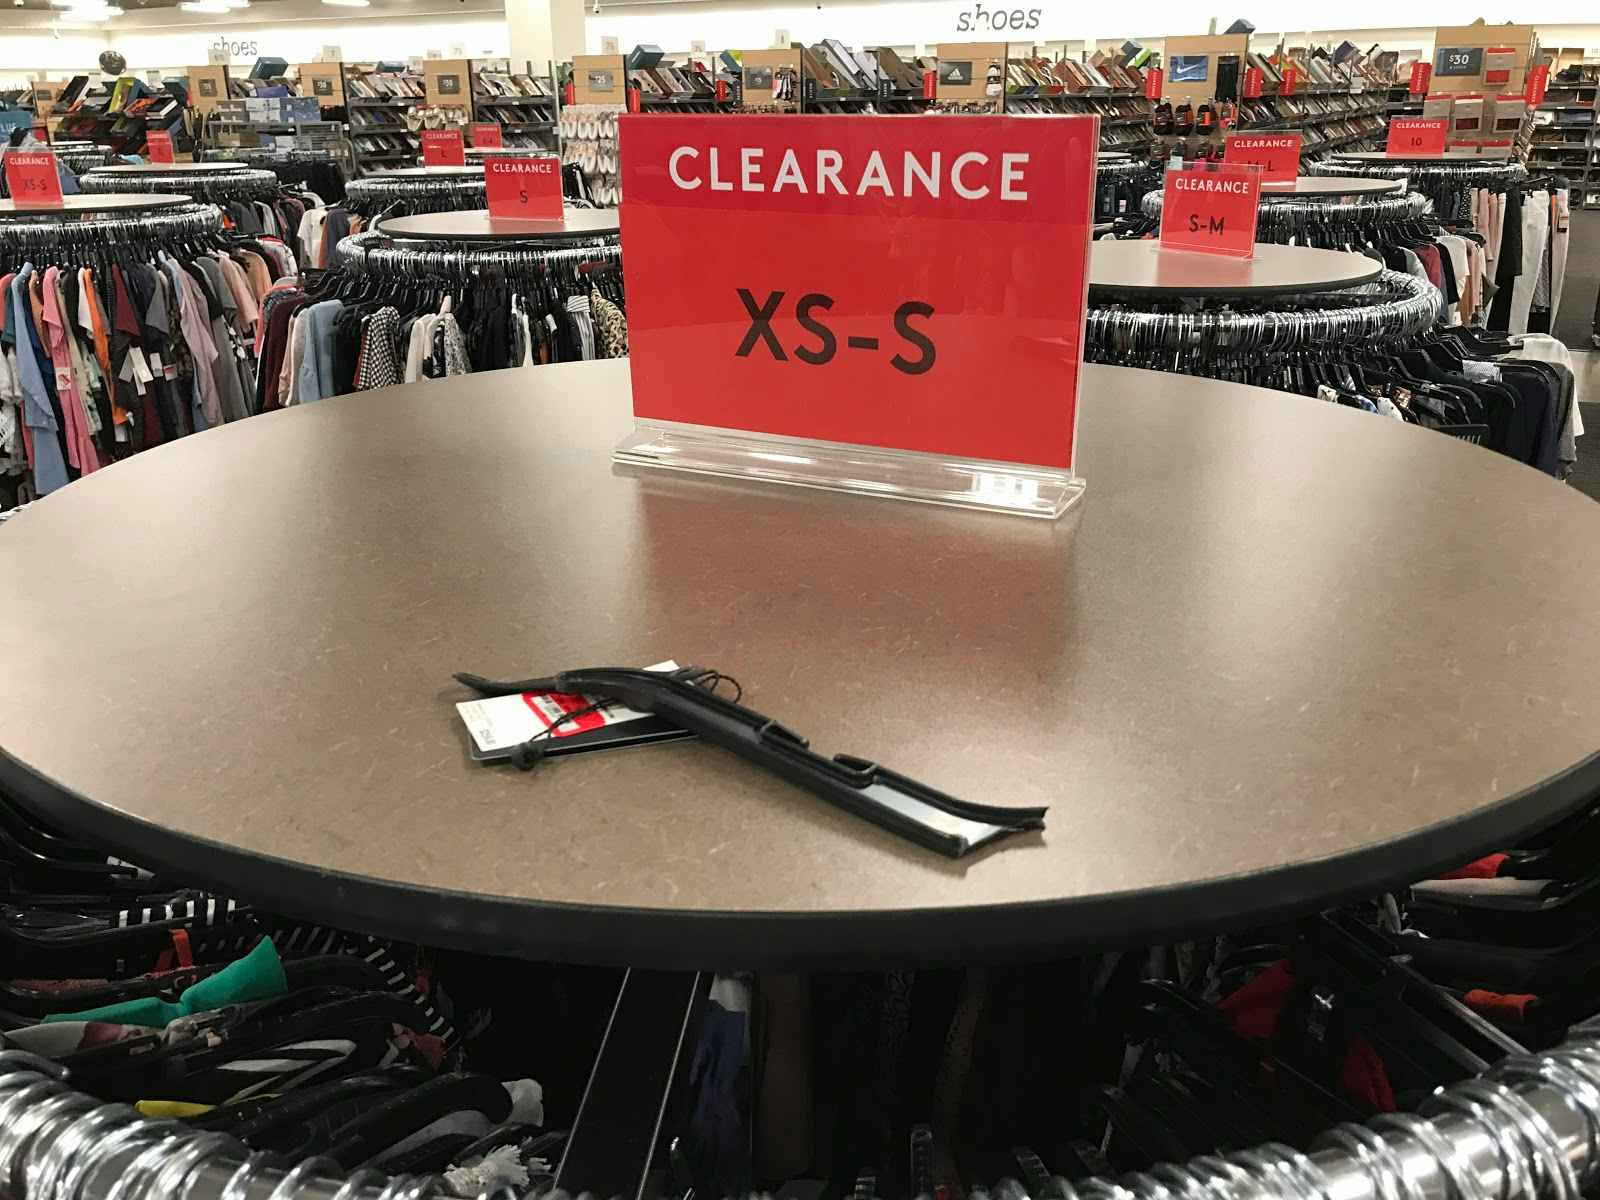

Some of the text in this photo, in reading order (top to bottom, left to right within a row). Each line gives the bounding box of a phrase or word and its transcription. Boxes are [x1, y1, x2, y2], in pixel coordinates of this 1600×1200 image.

[957, 4, 1042, 31] shoes
[1449, 54, 1470, 65] $30
[1234, 139, 1293, 148] CLEARANCE
[9, 156, 50, 166] CLEARANCE
[492, 163, 552, 174] CLEARANCE
[668, 145, 1030, 201] CLEARANCE
[1175, 178, 1249, 194] CLEARANCE
[519, 190, 528, 203] S
[1188, 214, 1225, 235] S-M
[735, 288, 937, 376] XS-S
